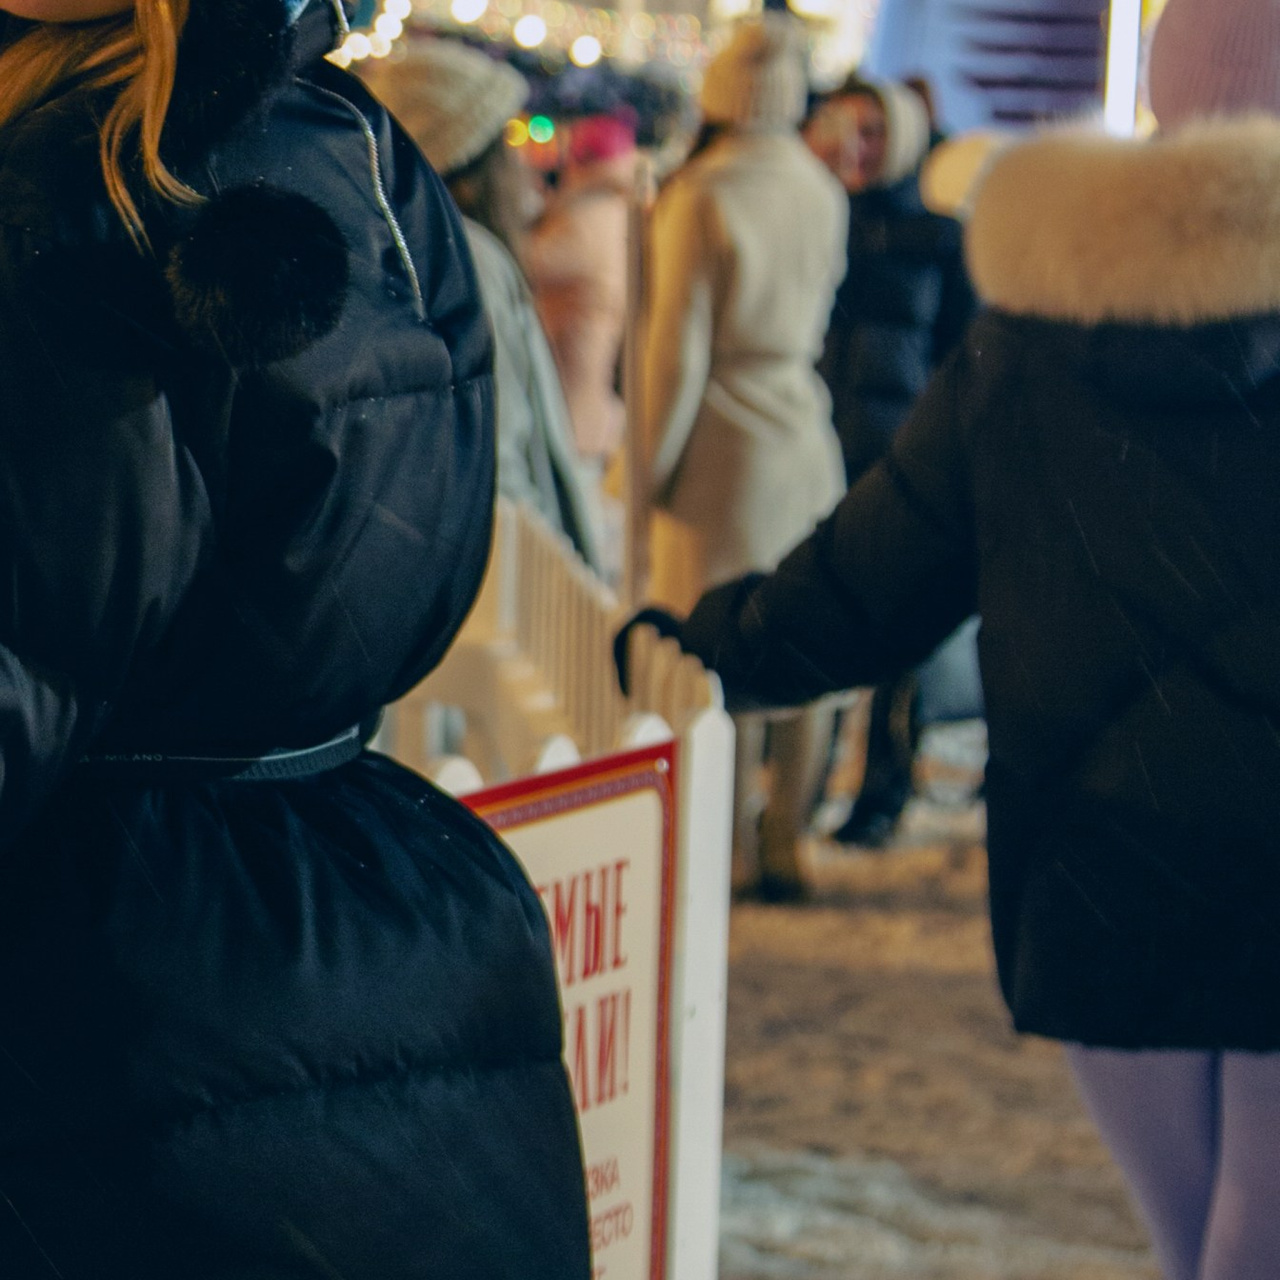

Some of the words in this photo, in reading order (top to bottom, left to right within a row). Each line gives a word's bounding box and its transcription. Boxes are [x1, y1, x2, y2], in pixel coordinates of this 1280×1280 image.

[536, 859, 629, 987] МЫЕ
[565, 988, 631, 1112] ЛИ!
[586, 1158, 620, 1200] ЗКА
